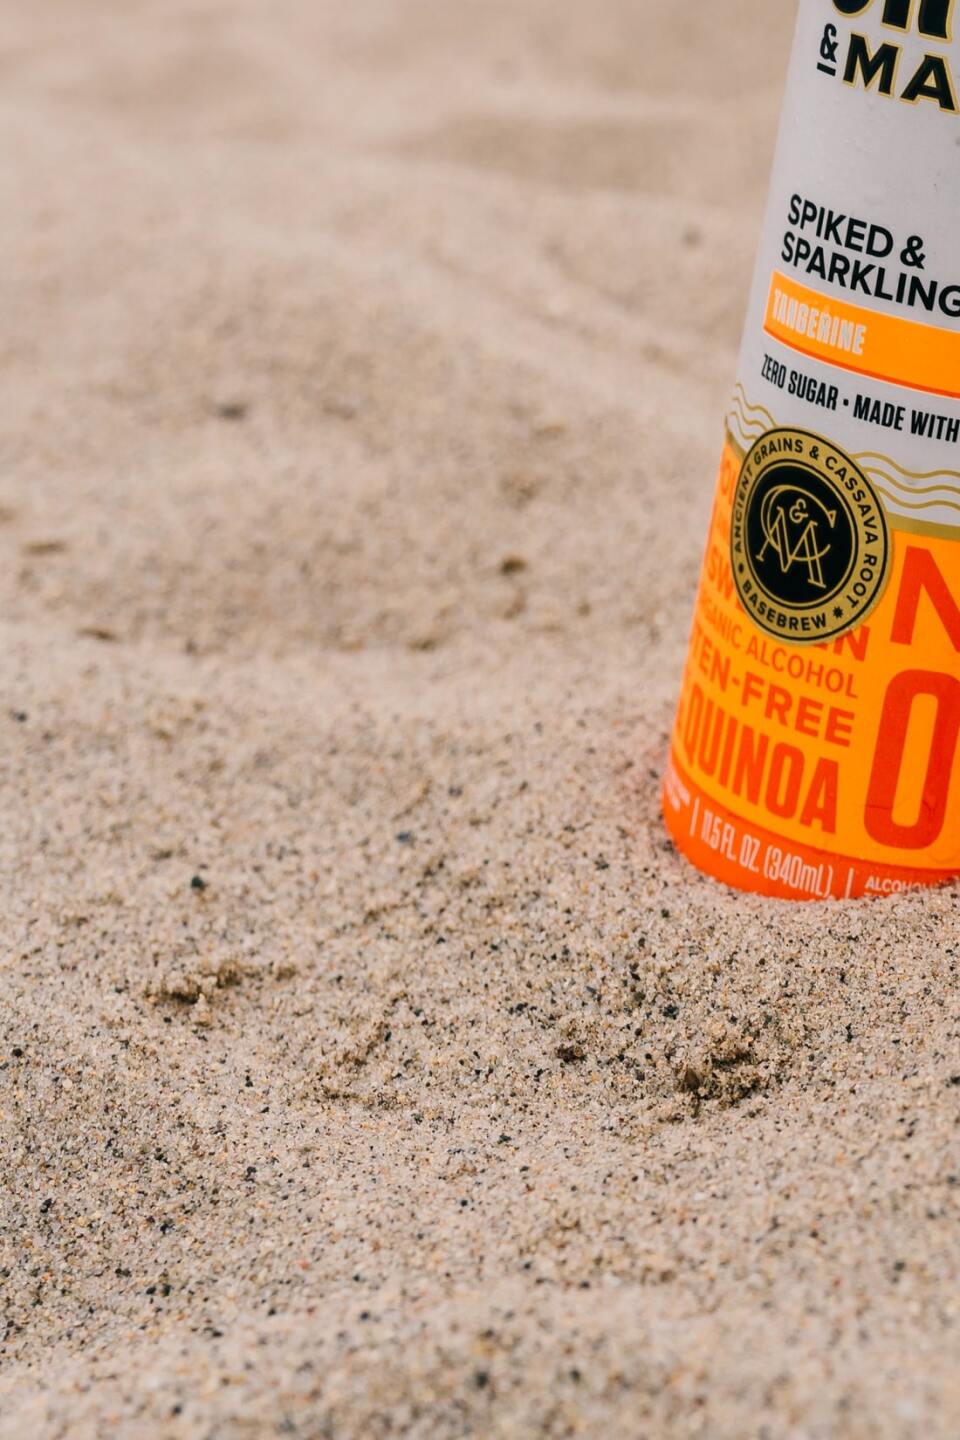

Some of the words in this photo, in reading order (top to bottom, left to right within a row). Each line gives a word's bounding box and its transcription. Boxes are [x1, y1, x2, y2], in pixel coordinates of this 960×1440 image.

[787, 193, 893, 258] SPIKED
[900, 235, 925, 269] &
[772, 288, 867, 355] TANGERINE
[761, 353, 786, 389] ZERO
[788, 372, 838, 411] SUGAR
[853, 395, 904, 431] MADE
[910, 412, 960, 443] WITH
[753, 438, 803, 466] GRAINS
[809, 446, 819, 461] &
[735, 466, 754, 553] ANCIENT
[825, 456, 878, 544] CASSAVA
[742, 580, 827, 631] BASEBREW
[847, 553, 878, 608] ROOT
[746, 635, 858, 699] ALCOHOL
